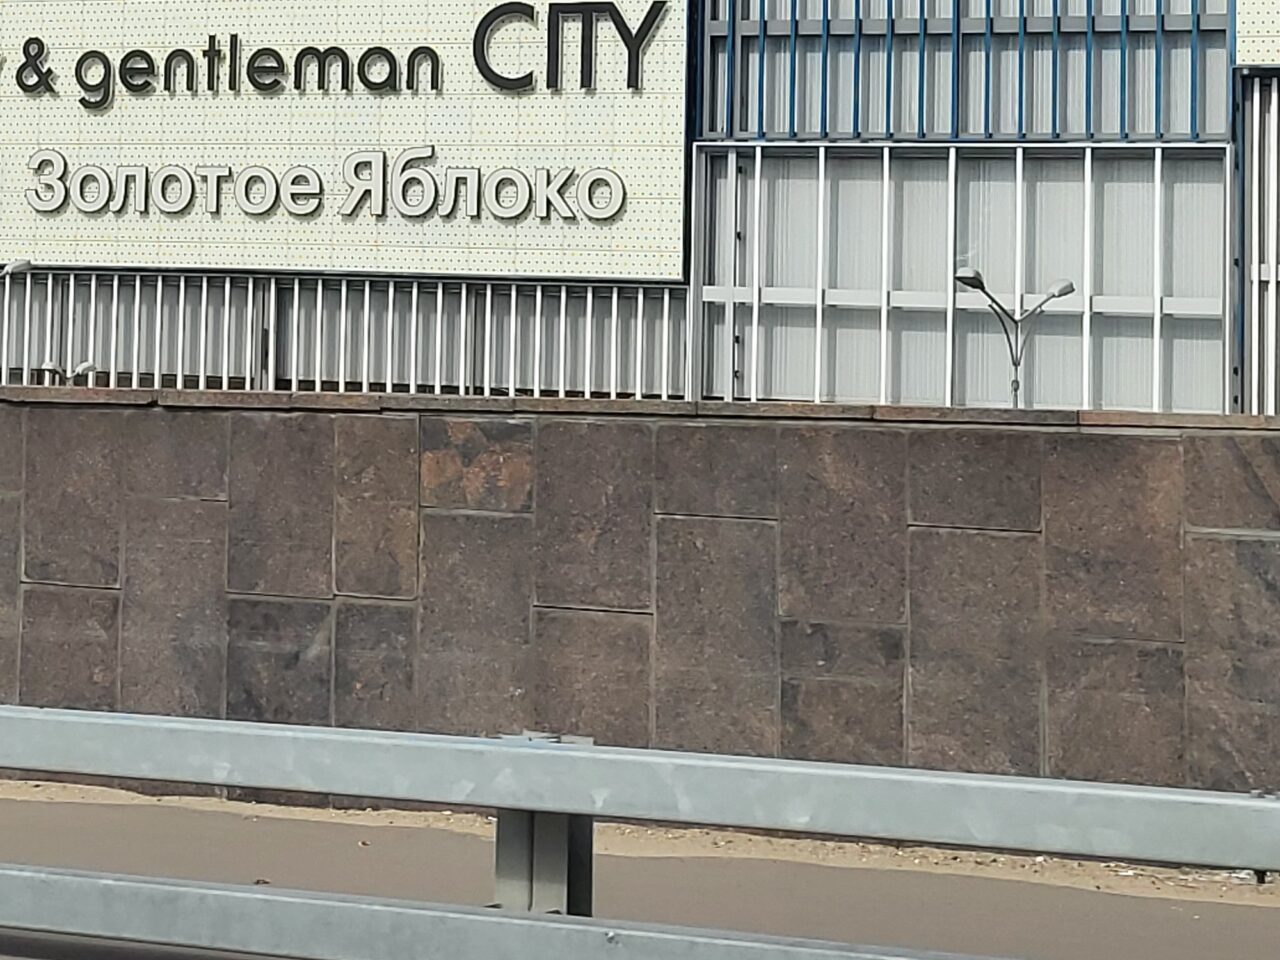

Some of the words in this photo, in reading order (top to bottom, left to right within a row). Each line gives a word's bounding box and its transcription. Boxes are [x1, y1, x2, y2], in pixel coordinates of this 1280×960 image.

[15, 36, 60, 95] &
[74, 33, 442, 110] gentleman
[472, 0, 670, 92] CITY
[24, 148, 324, 216] Золотое
[338, 145, 627, 220] Яблоко
